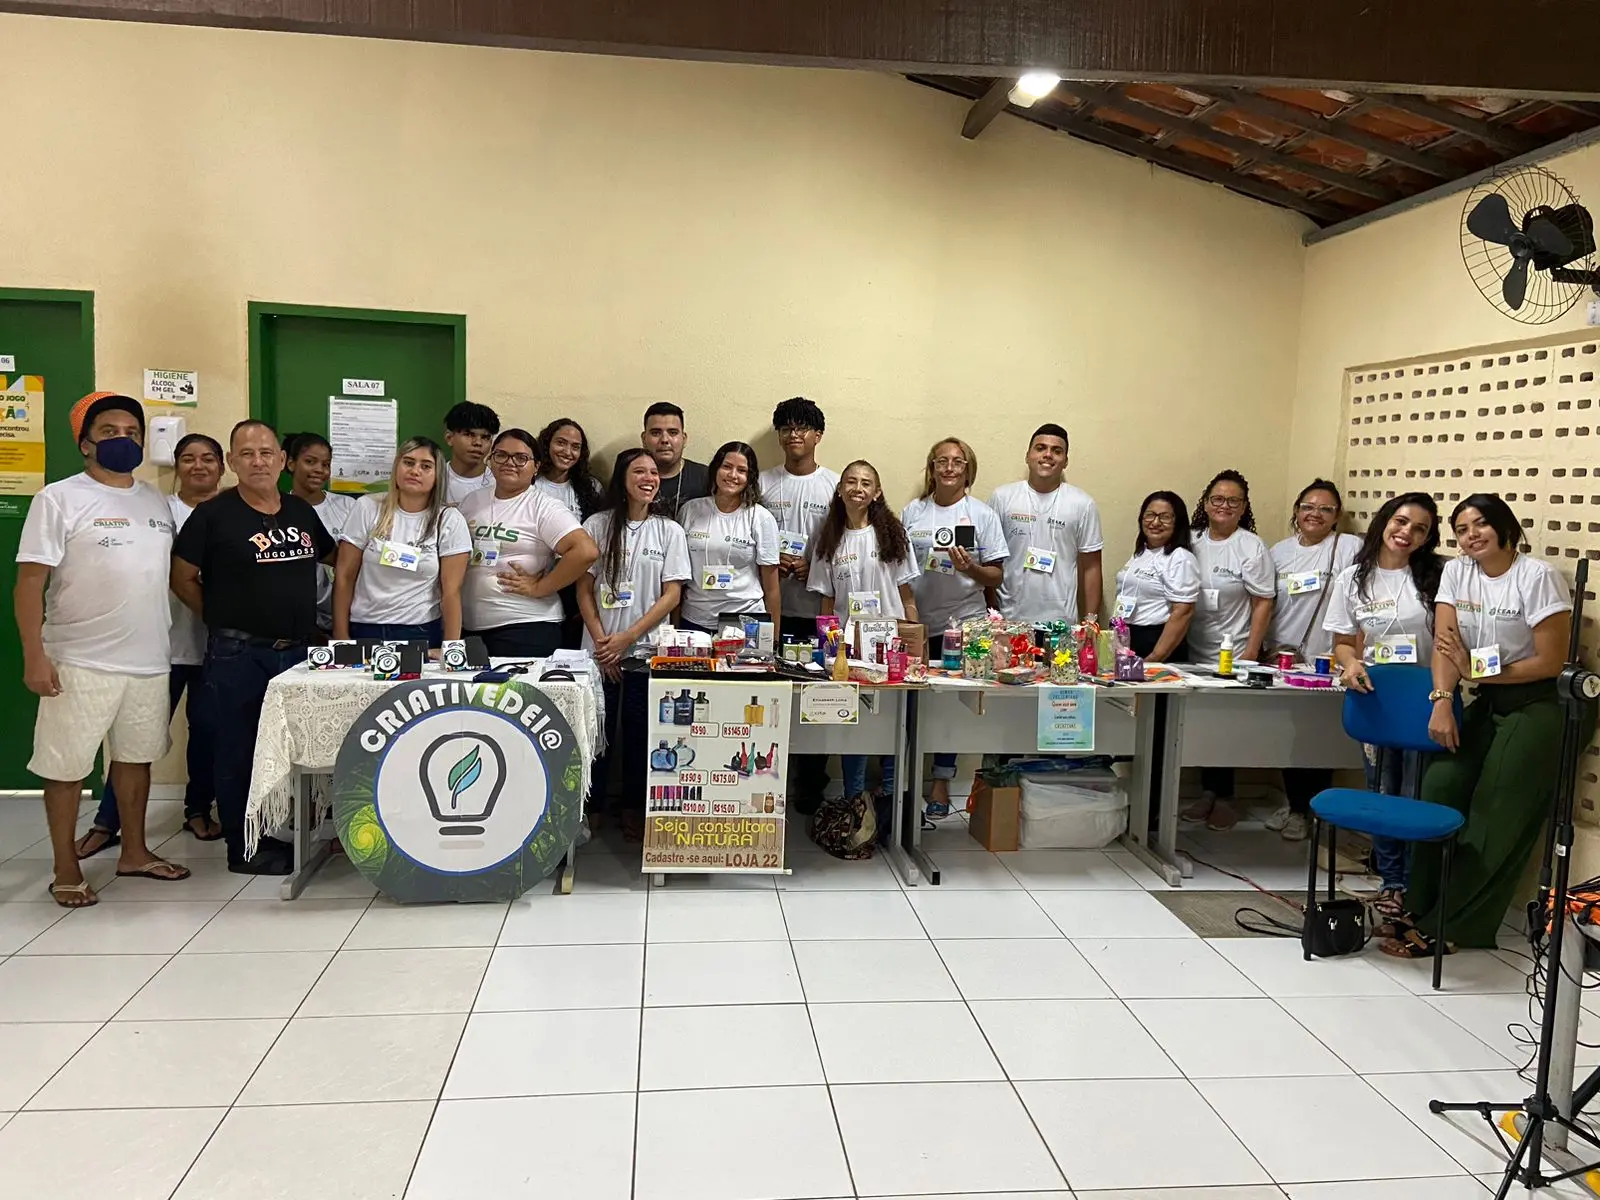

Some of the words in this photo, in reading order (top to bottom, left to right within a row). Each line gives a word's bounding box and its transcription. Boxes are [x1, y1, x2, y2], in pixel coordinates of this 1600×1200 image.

[151, 379, 176, 387] ÁLCOOL
[153, 372, 188, 380] HIGIENE
[249, 526, 312, 552] BOSS
[255, 551, 286, 559] HUGO
[289, 547, 315, 557] BOSS
[360, 683, 562, 752] CRIATIVEDEI@
[654, 818, 689, 836] Seja
[698, 819, 776, 833] consultora
[676, 833, 753, 846] NATURA
[645, 852, 684, 863] Cadastre
[702, 854, 724, 865] aqui:
[725, 853, 759, 867] LOJA
[763, 854, 778, 868] 22
